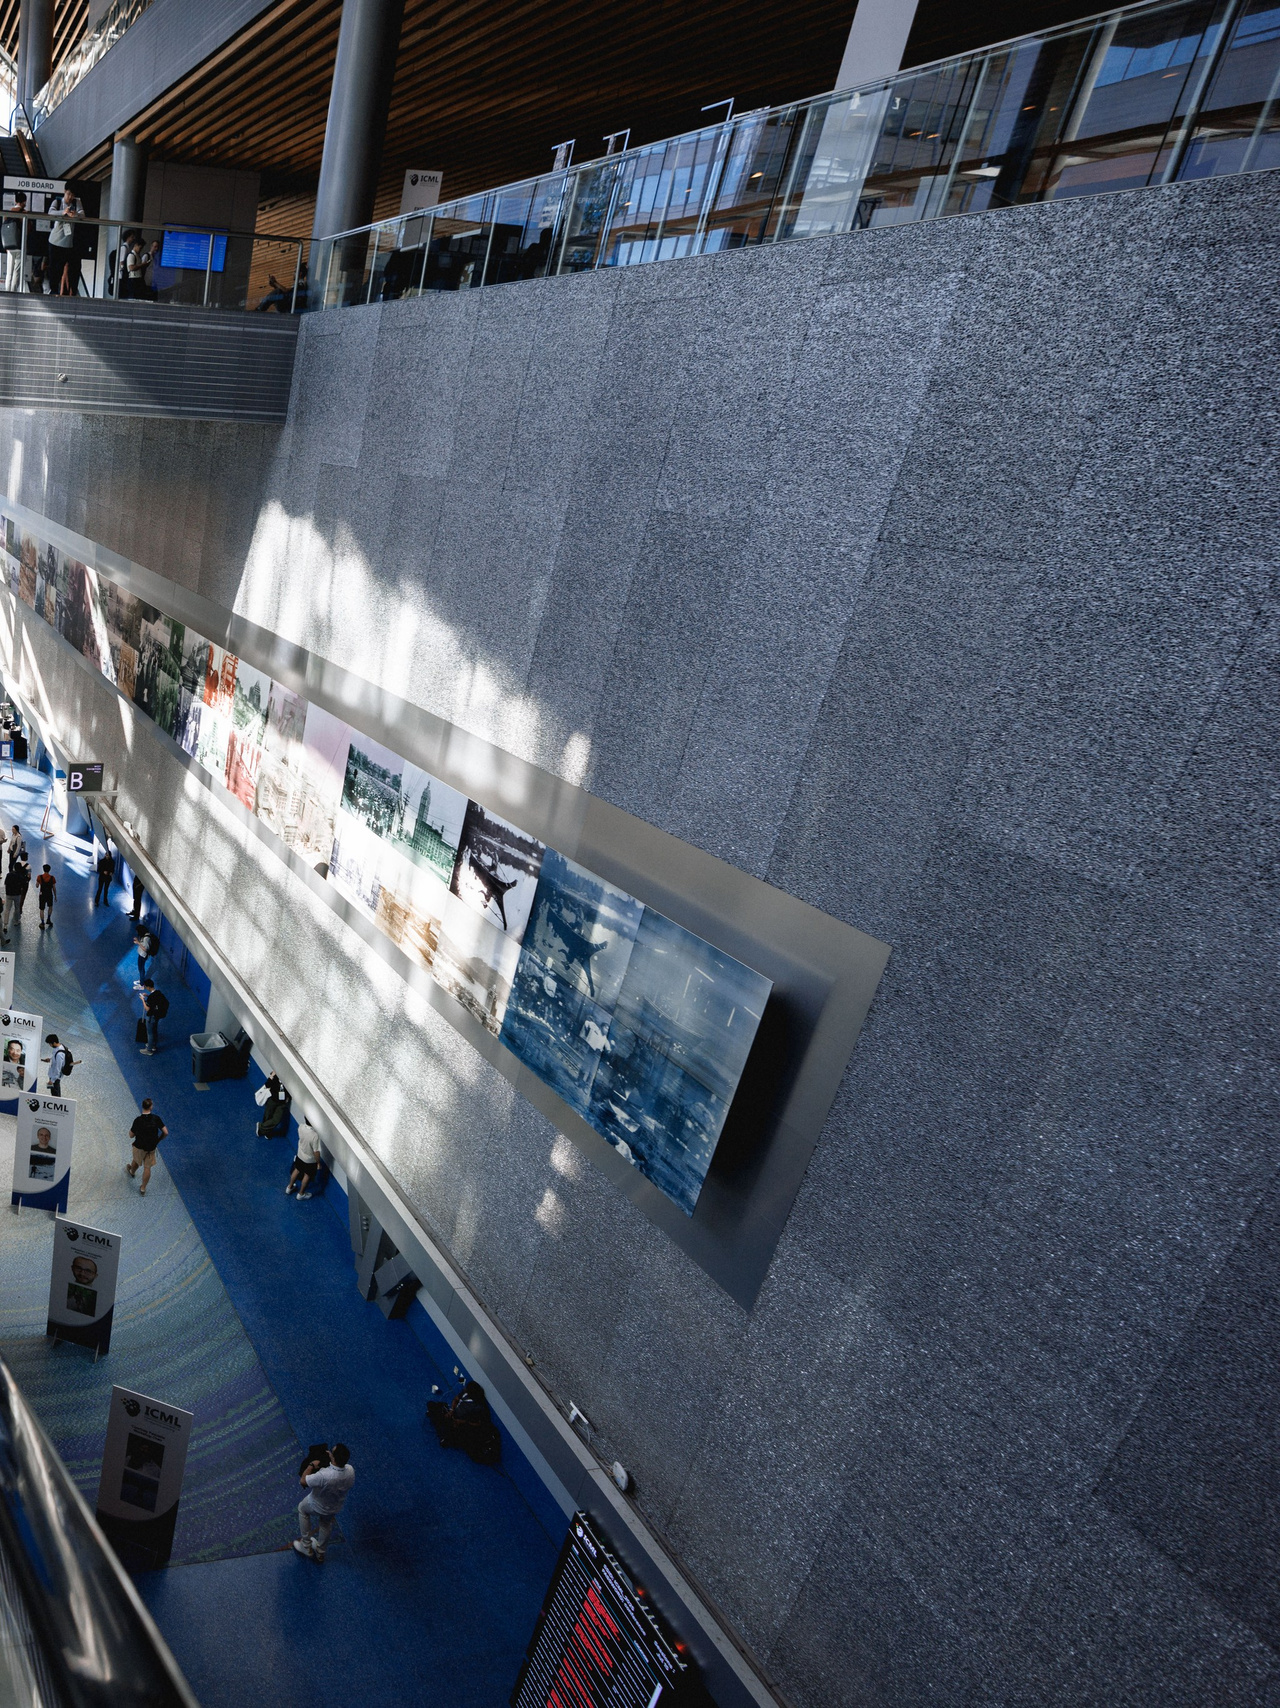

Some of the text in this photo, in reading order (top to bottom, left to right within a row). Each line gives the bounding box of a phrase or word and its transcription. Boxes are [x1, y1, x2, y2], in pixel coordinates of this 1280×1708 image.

[71, 772, 83, 789] B
[14, 1017, 36, 1027] ICML
[43, 1102, 69, 1112] ICML
[82, 1232, 112, 1247] ICML
[145, 1406, 181, 1427] ICML
[583, 1534, 597, 1558] ICML
[624, 1603, 646, 1636] conference
